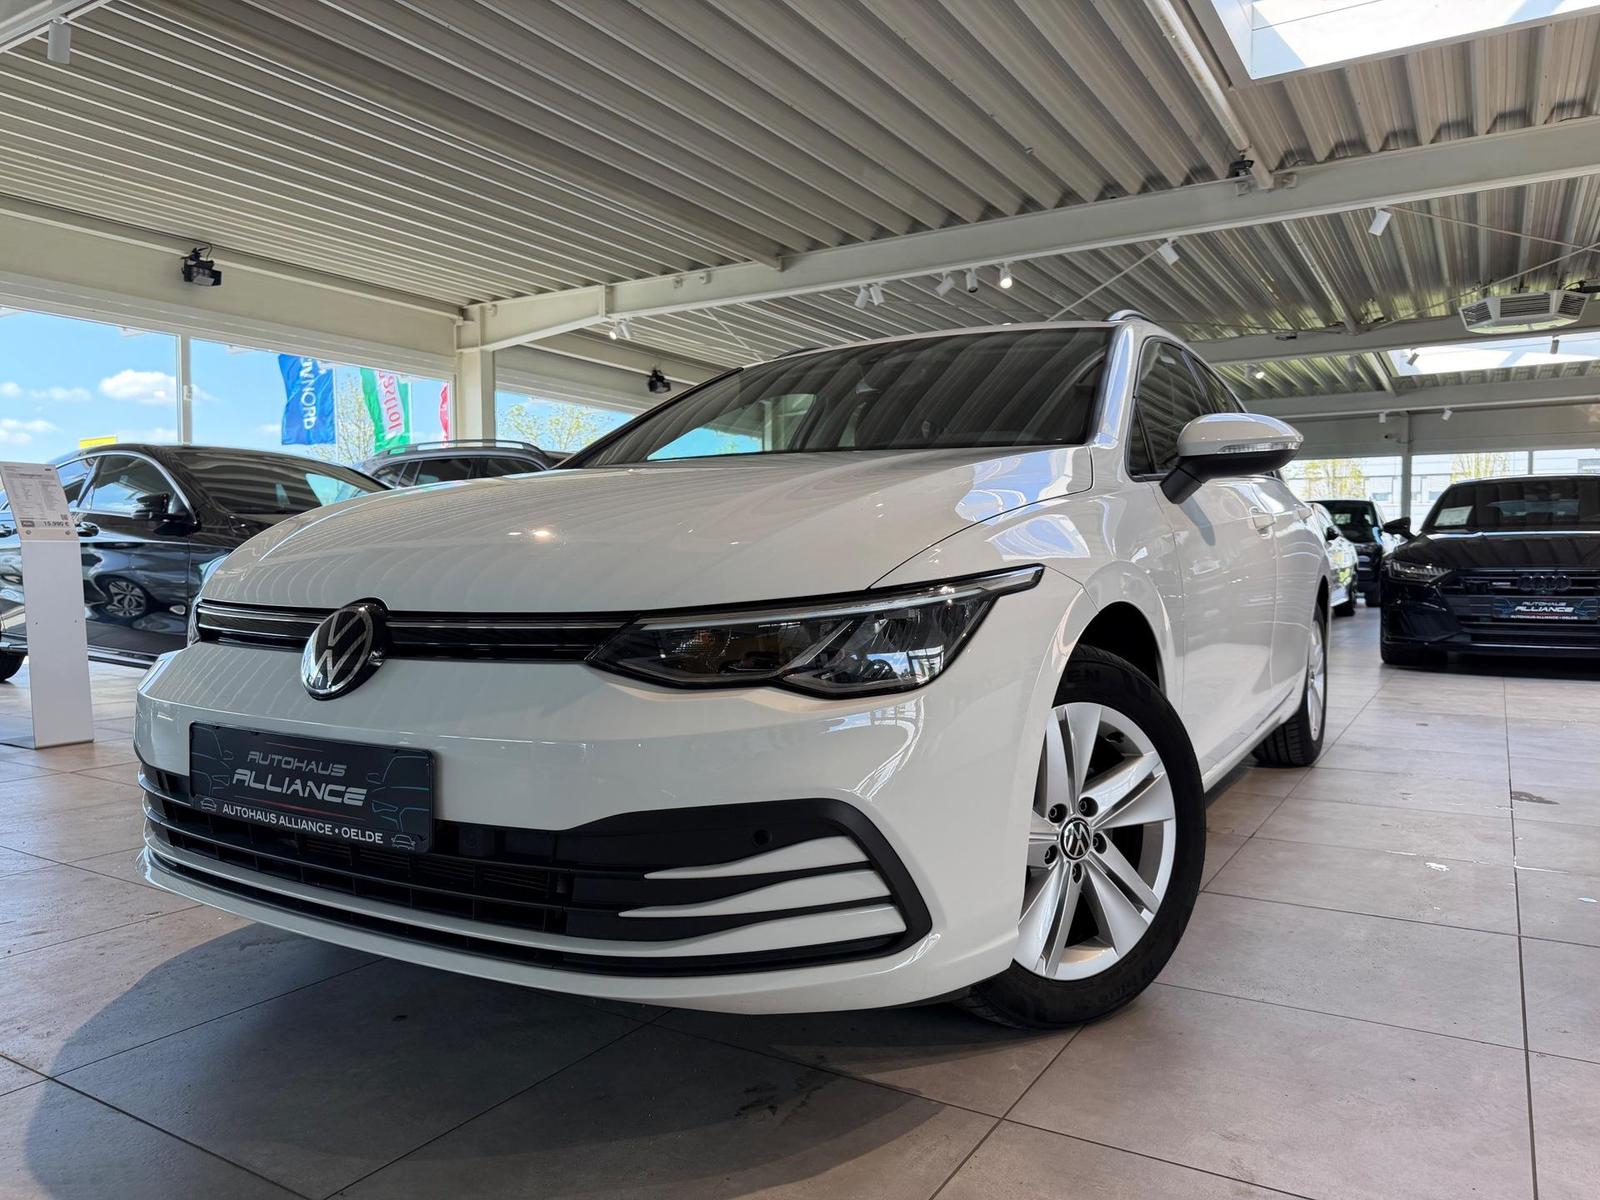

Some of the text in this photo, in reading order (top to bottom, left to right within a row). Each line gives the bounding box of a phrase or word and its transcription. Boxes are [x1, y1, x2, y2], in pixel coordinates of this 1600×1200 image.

[247, 751, 347, 777] AUTOHAUS
[232, 768, 368, 806] ALLIANCE
[223, 804, 384, 844] AUTOHAUS ALLIANCE OELDE
